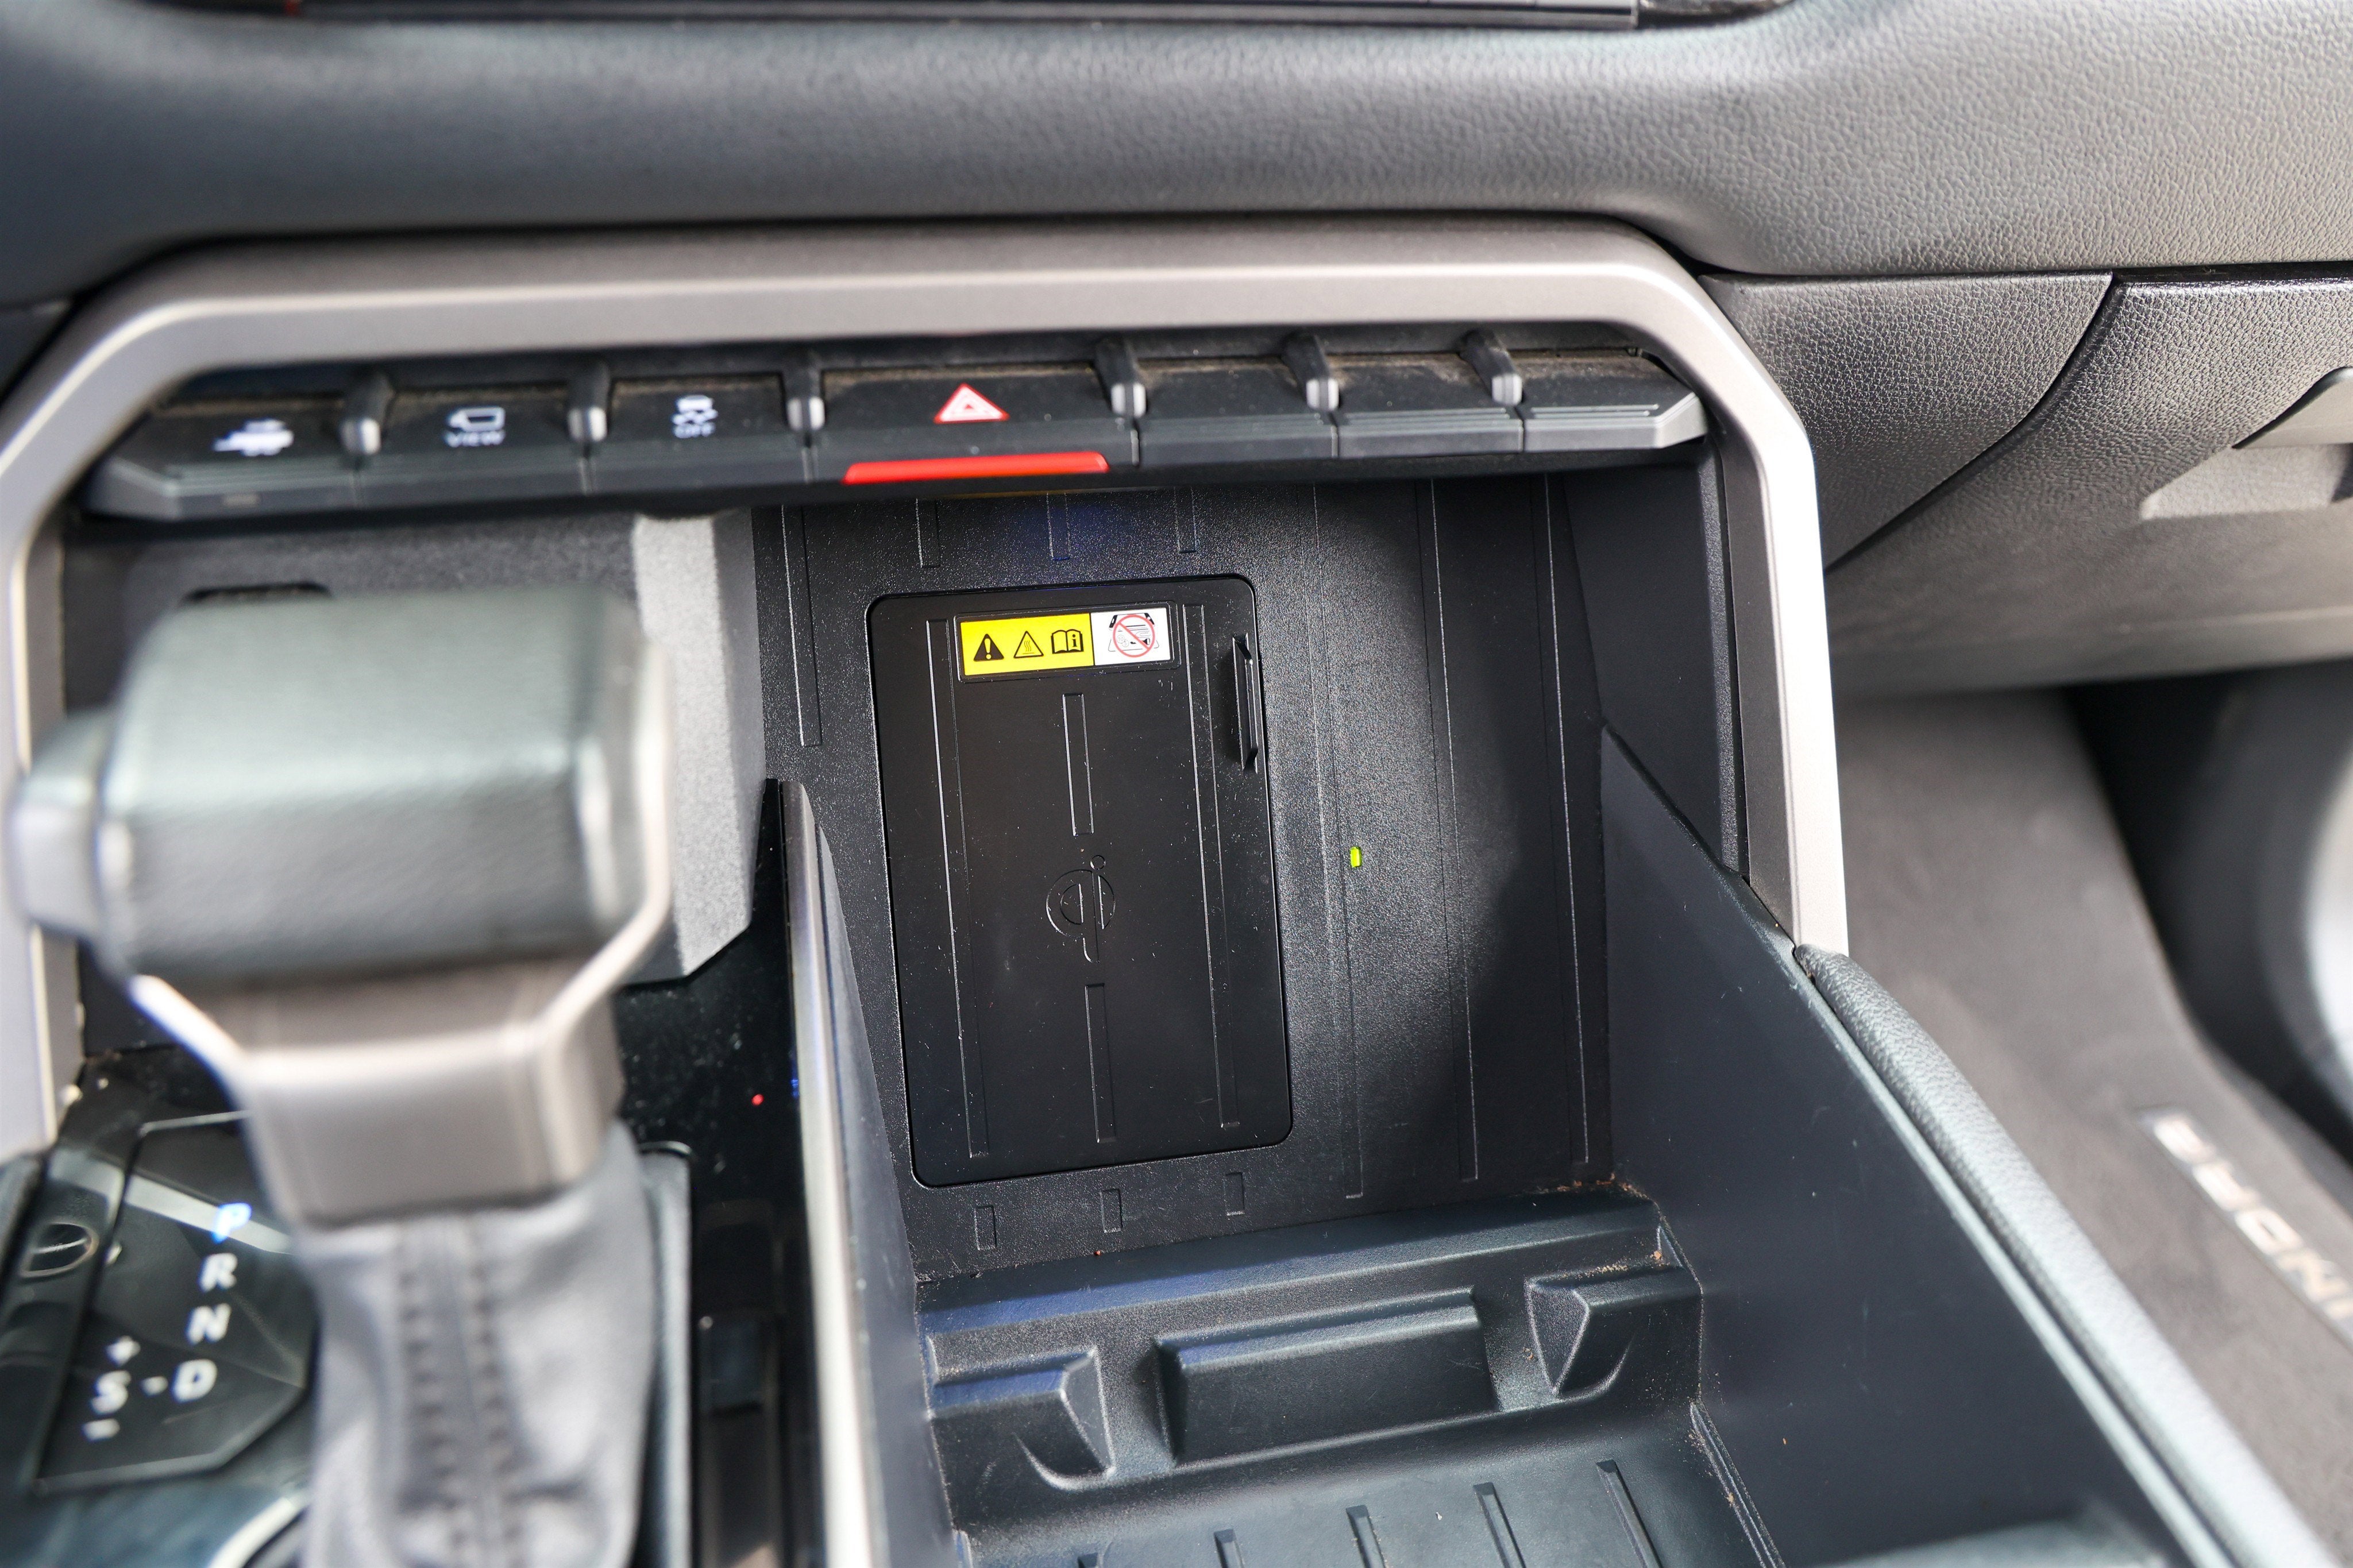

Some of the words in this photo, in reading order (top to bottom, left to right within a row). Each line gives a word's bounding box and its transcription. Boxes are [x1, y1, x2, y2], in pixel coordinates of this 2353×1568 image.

[443, 430, 506, 447] VIEW
[674, 423, 715, 438] OFF
[211, 1203, 252, 1243] P
[198, 1253, 237, 1291] R
[186, 1304, 230, 1343] N
[92, 1372, 129, 1413] S
[172, 1360, 217, 1402] D
